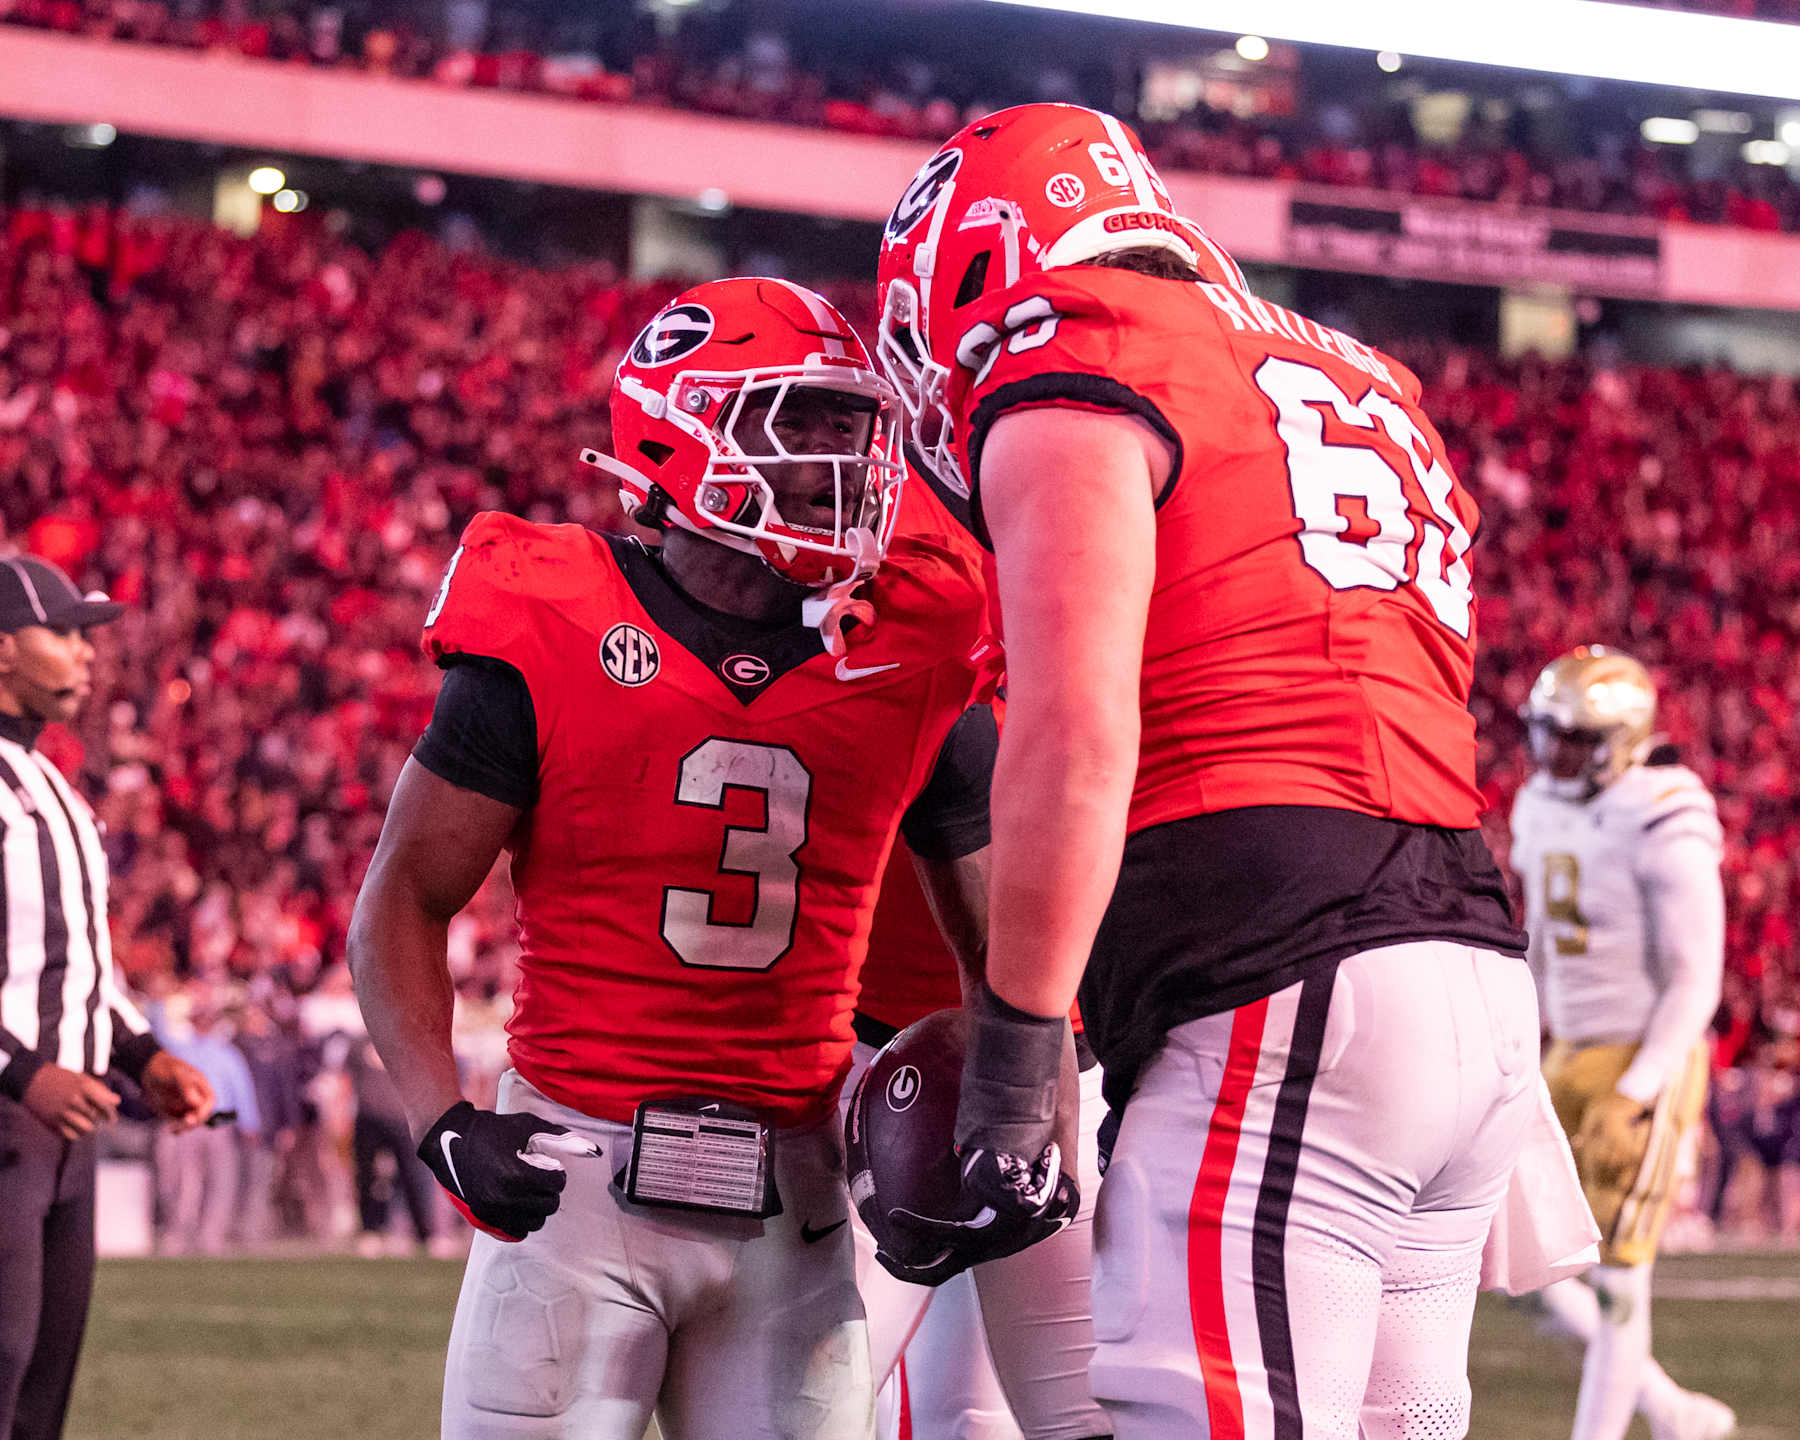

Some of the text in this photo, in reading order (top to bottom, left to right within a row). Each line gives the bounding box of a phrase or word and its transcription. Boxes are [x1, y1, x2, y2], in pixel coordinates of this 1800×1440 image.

[1049, 176, 1081, 203] SEC
[604, 625, 657, 684] SEC
[660, 736, 811, 971] 3
